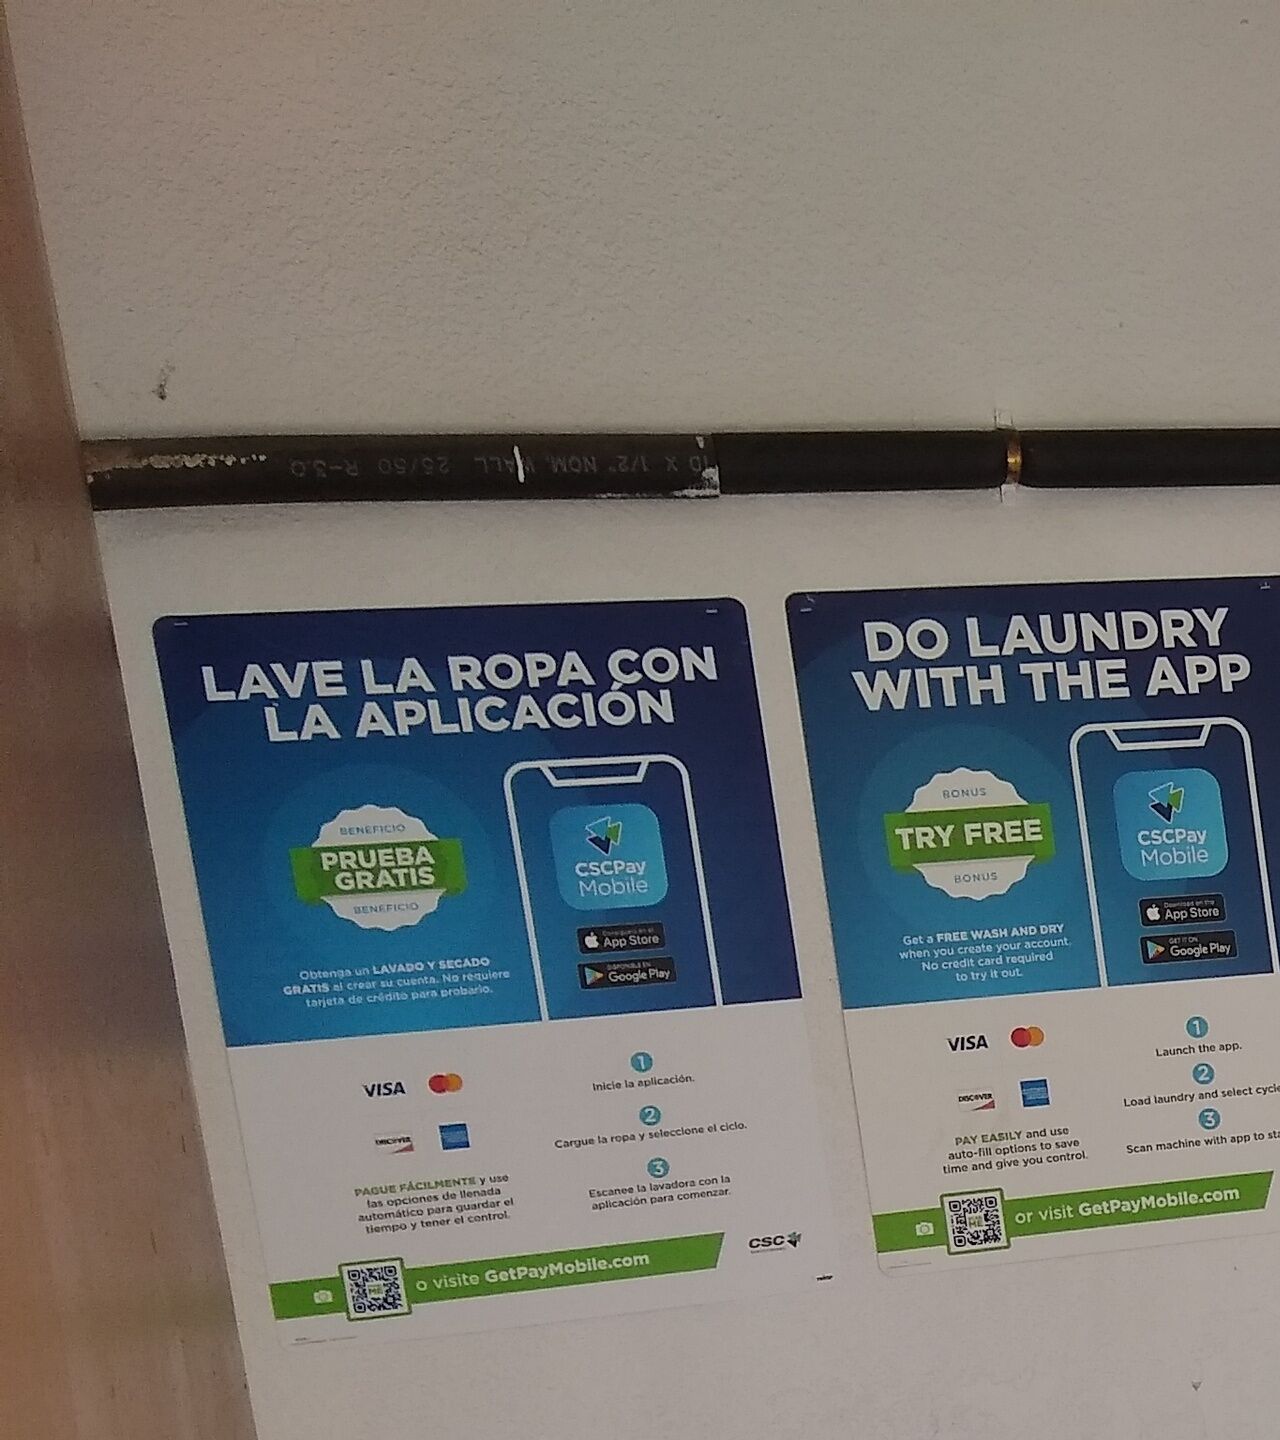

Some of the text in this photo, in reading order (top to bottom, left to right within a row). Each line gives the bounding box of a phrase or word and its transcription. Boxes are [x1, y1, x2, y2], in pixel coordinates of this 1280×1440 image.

[863, 606, 1229, 662] DO LAUNDRY
[201, 646, 718, 702] LAVE LA ROPA CON
[851, 653, 1251, 712] WITH THE APP
[264, 681, 675, 742] LA APLICACIÓN
[942, 787, 987, 799] BONUS
[339, 823, 406, 836] BENEFICIO
[894, 818, 1044, 851] TRY FREE
[1137, 828, 1207, 846] CSCPay
[320, 845, 436, 872] PRUEBA
[1140, 846, 1209, 867] Mobile
[575, 860, 646, 877] CSCPay
[334, 866, 436, 891] GRATIS
[954, 871, 999, 884] BONUS
[578, 876, 649, 897] Mobile
[353, 902, 420, 914] BENEFICIO
[1164, 906, 1220, 922] App Store
[603, 934, 660, 949] App Store
[903, 923, 1065, 946] Get a FREE WASH AND DRY
[1170, 941, 1231, 958] Google Play
[608, 967, 671, 983] Google Play
[947, 1034, 989, 1051] VISA
[1155, 1042, 1243, 1057] Launch the app.
[362, 1081, 407, 1098] VISA
[592, 1073, 695, 1091] Inicie la aplicación.
[958, 1092, 993, 1103] DISCOVER
[1204, 1111, 1215, 1126] 3
[1126, 1142, 1153, 1154] Scan
[1155, 1137, 1201, 1151] machine
[1204, 1134, 1227, 1146] with
[1229, 1133, 1251, 1144] app
[1253, 1131, 1265, 1141] to
[1015, 1187, 1240, 1225] or visit GetPayMobile.com
[748, 1234, 785, 1249] CSC
[416, 1252, 650, 1292] o visite GetPayMobile.com
